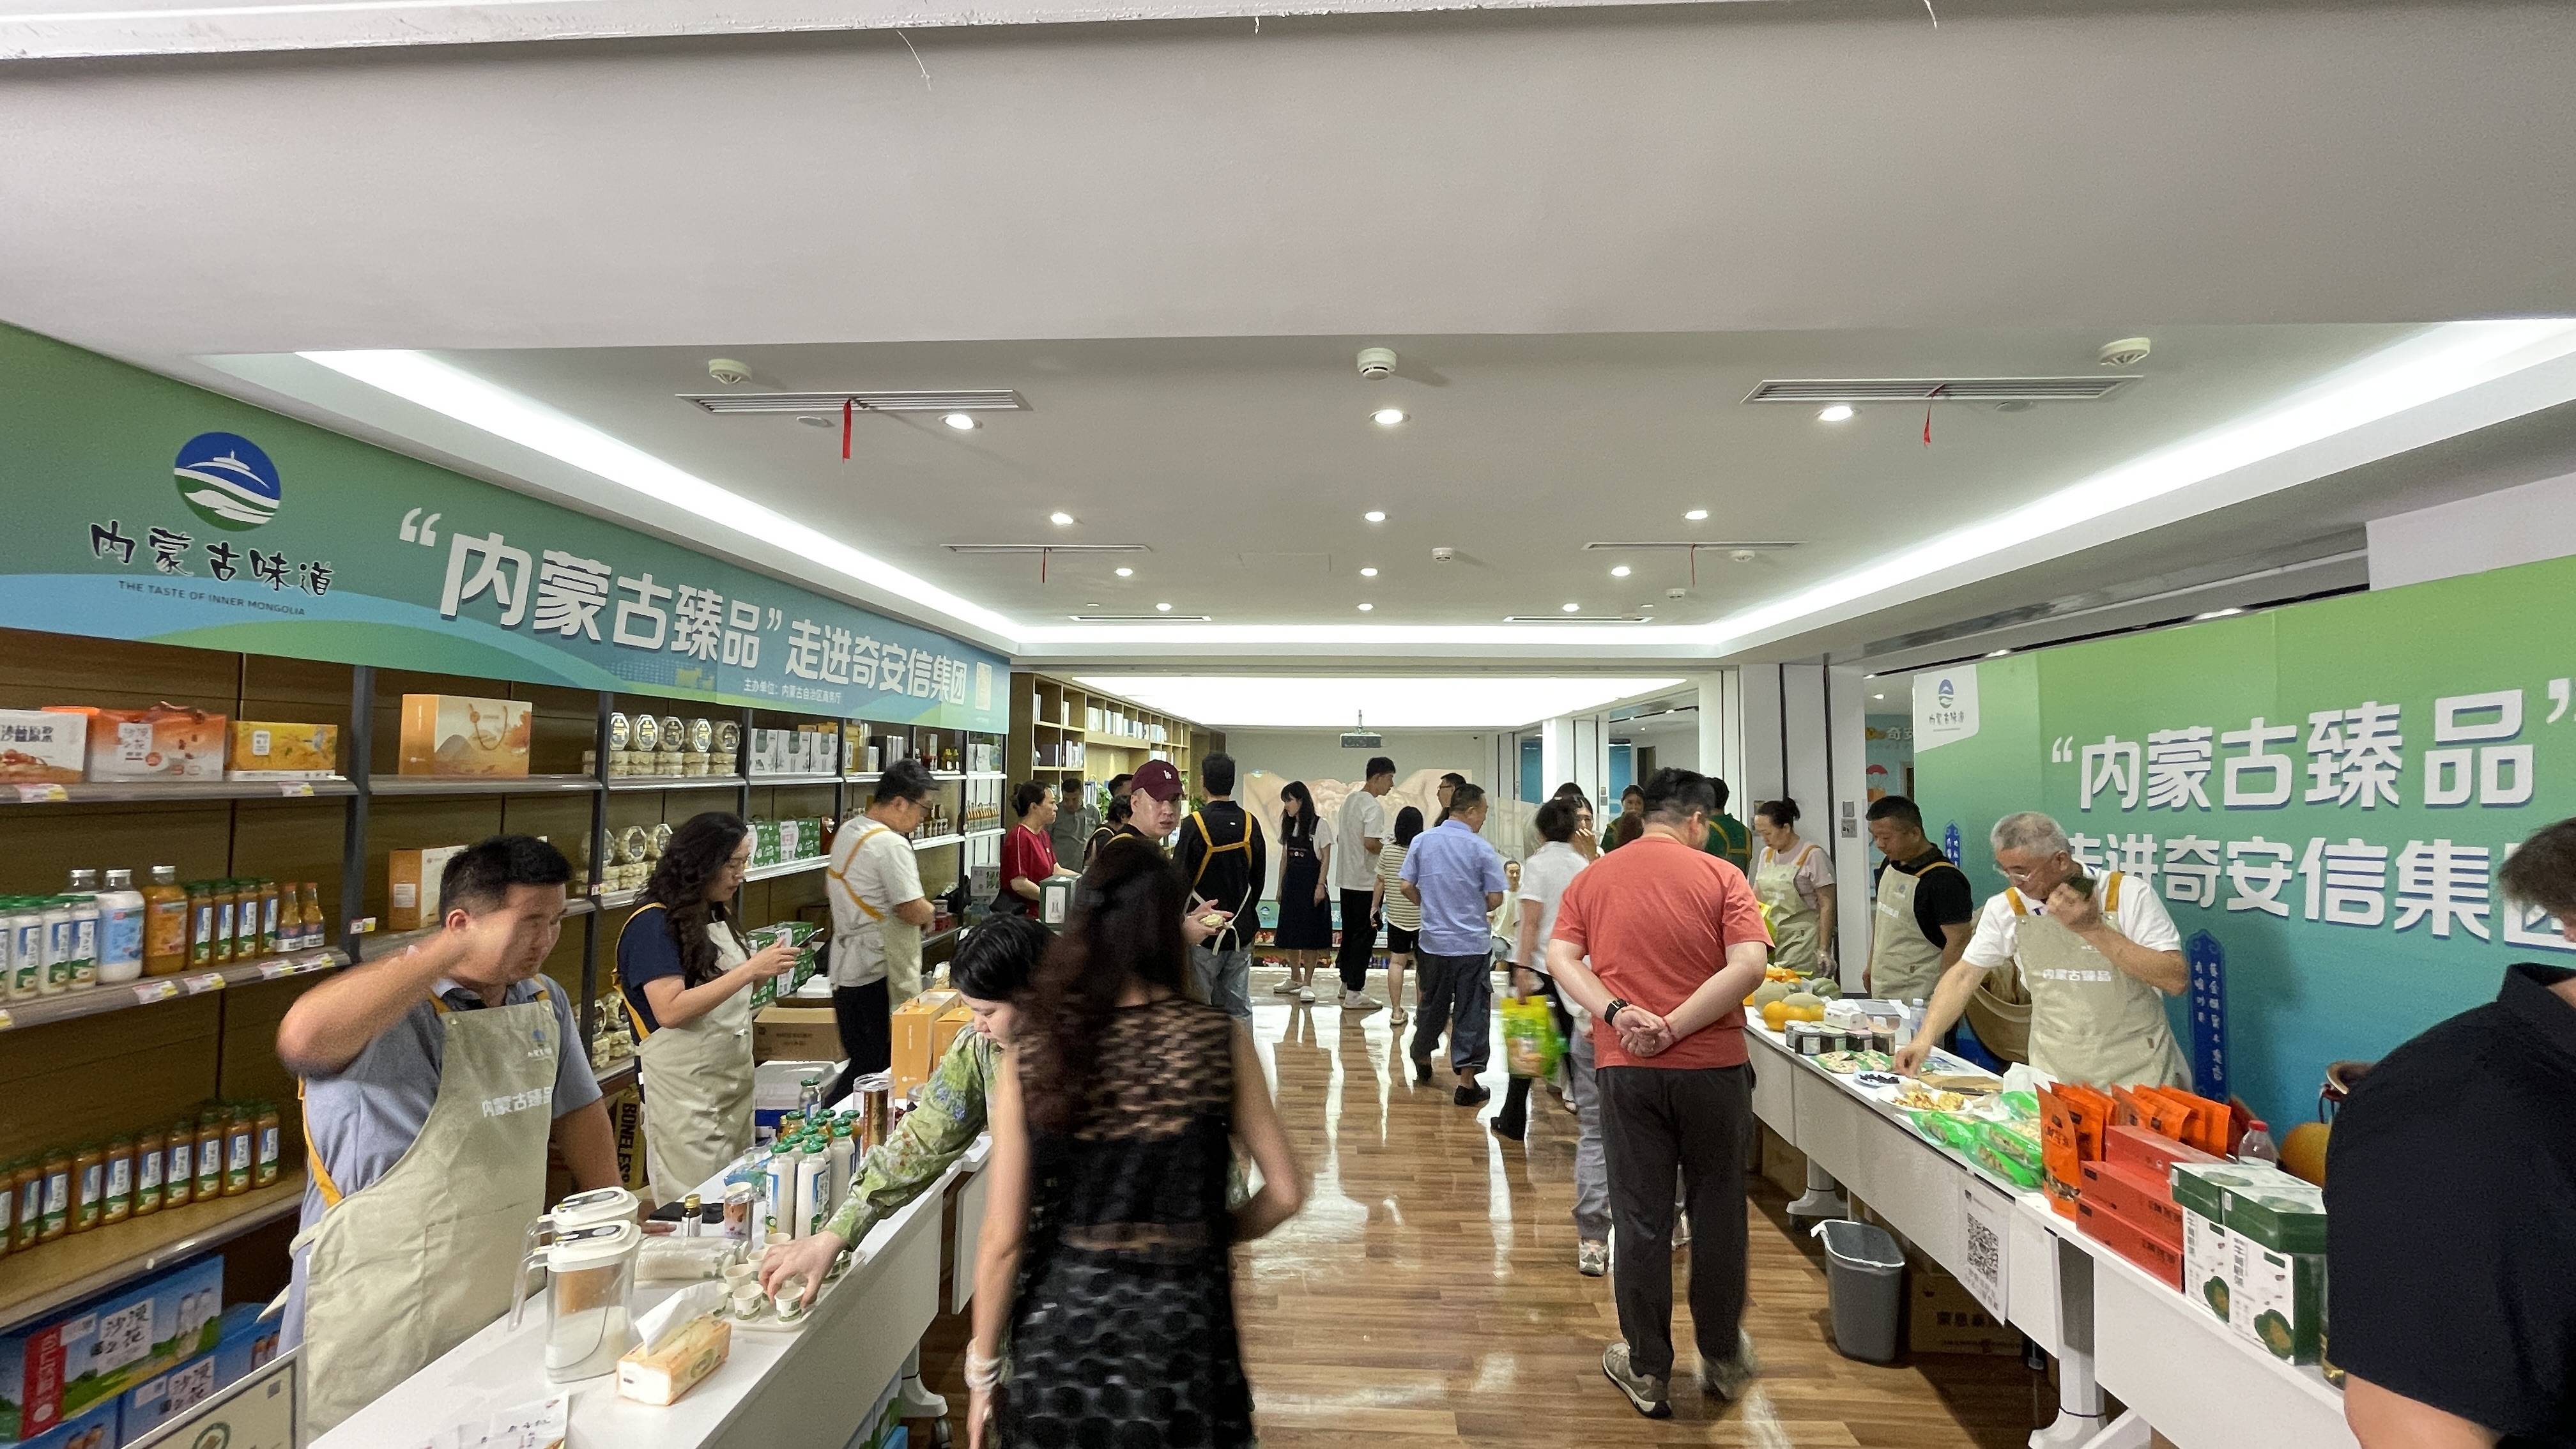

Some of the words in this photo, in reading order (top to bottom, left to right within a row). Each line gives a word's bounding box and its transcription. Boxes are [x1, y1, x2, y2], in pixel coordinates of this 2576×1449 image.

[91, 520, 333, 595] 内蒙古味道
[118, 580, 143, 592] THE
[148, 585, 185, 599] TASTE
[189, 590, 206, 601] OF
[208, 595, 244, 607] INNER
[247, 601, 306, 616] MONGOLIA
